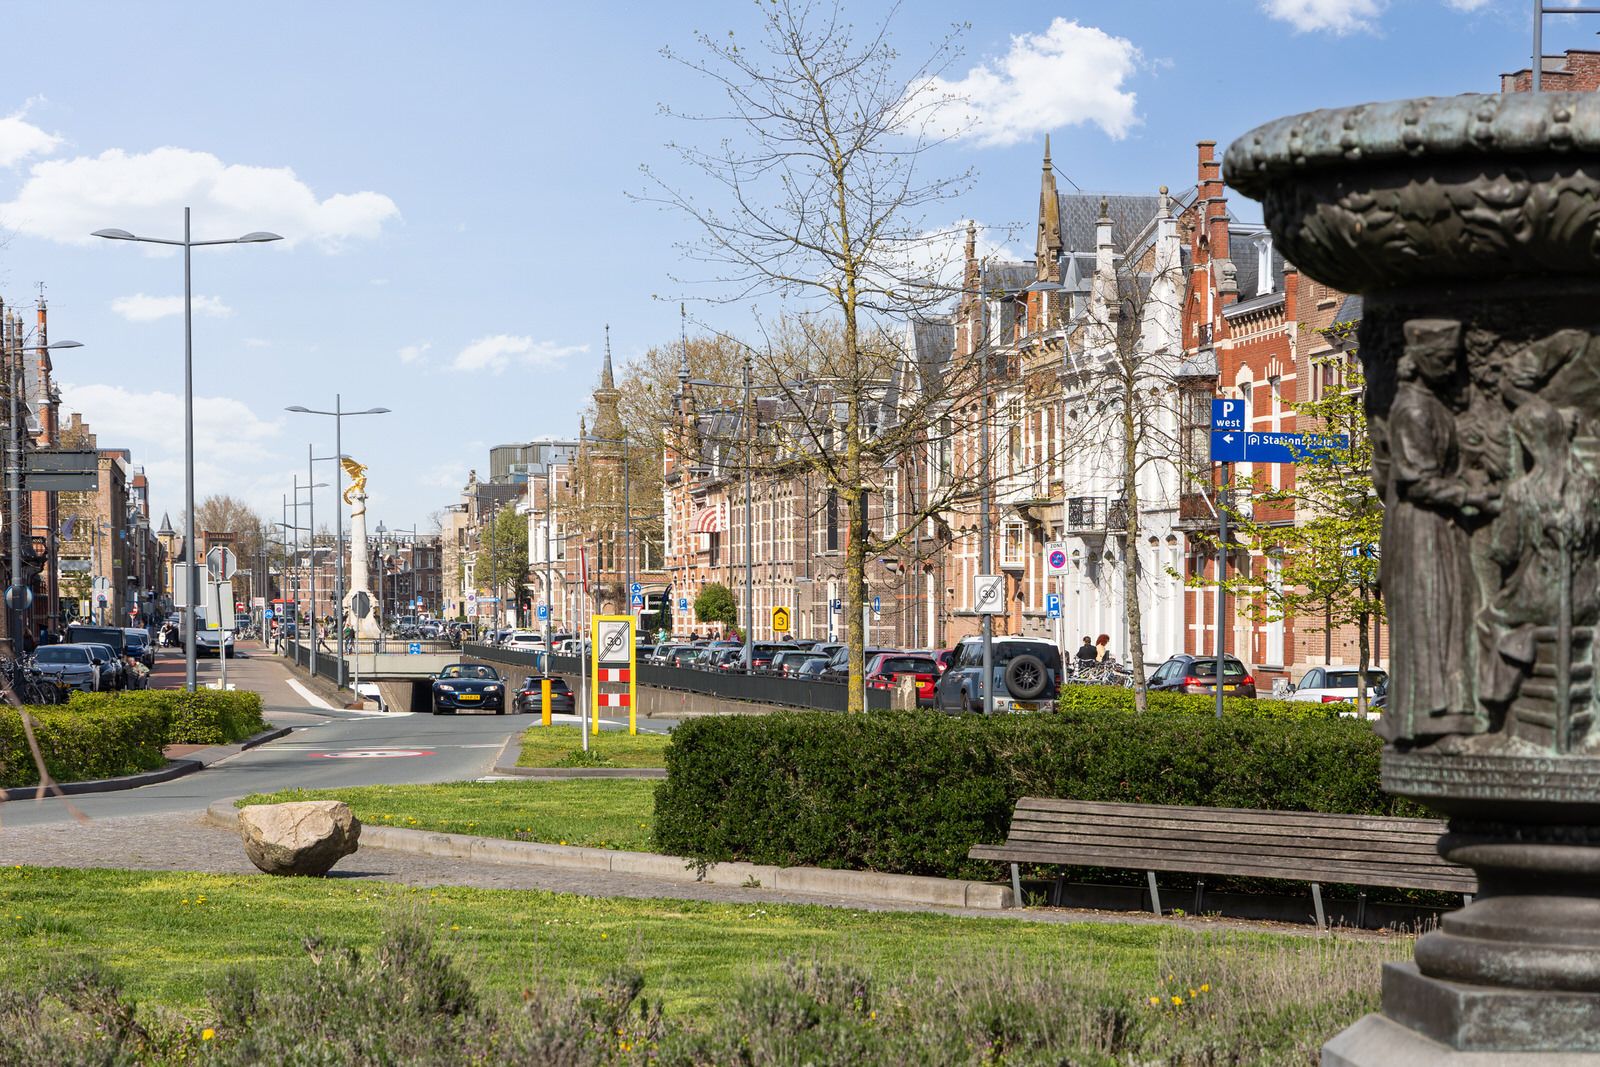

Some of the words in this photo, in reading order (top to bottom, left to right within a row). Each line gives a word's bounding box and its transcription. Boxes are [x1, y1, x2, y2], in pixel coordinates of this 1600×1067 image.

[1223, 401, 1234, 418] P
[1216, 419, 1241, 427] west
[982, 590, 996, 599] 30
[1050, 596, 1059, 608] P
[777, 617, 785, 626] 3
